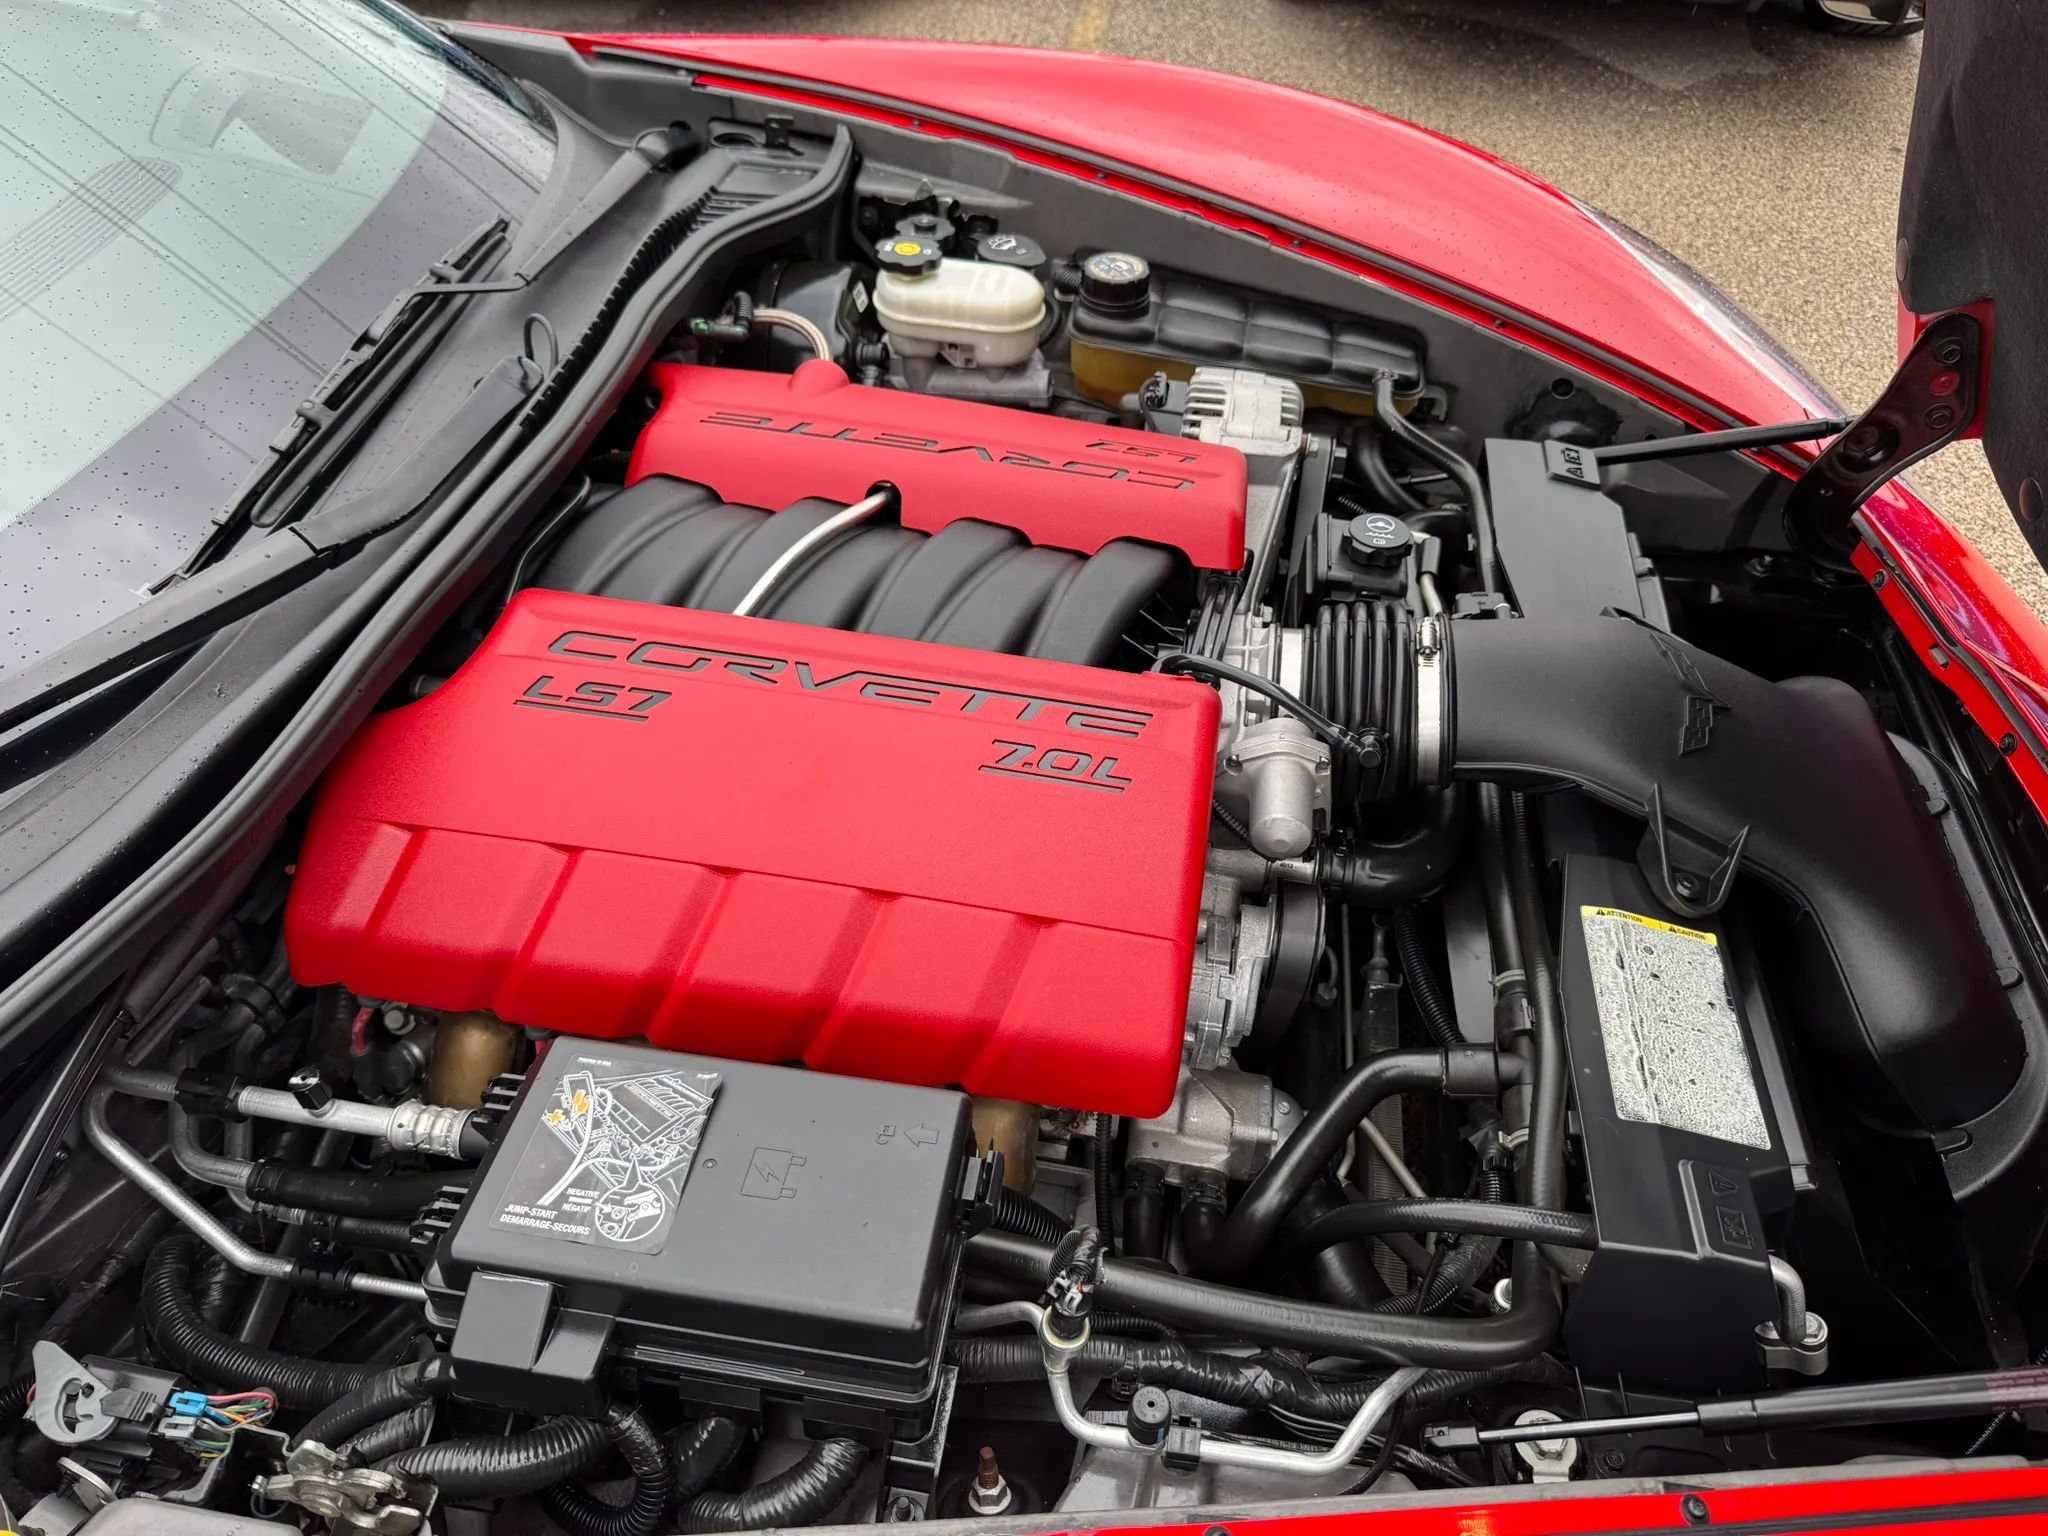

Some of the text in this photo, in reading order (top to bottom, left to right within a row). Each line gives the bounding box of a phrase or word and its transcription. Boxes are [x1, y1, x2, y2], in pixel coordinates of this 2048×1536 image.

[701, 411, 1196, 490] CORVETTE
[1084, 439, 1201, 464] LS7
[522, 675, 672, 710] LS7
[547, 631, 1154, 738] CORVETTE
[990, 739, 1132, 785] 7.0L
[1606, 911, 1643, 923] ATTENTION
[1677, 928, 1706, 941] CAUTION
[566, 1187, 600, 1199] NEGATIVE
[505, 1204, 558, 1219] JUMP-START
